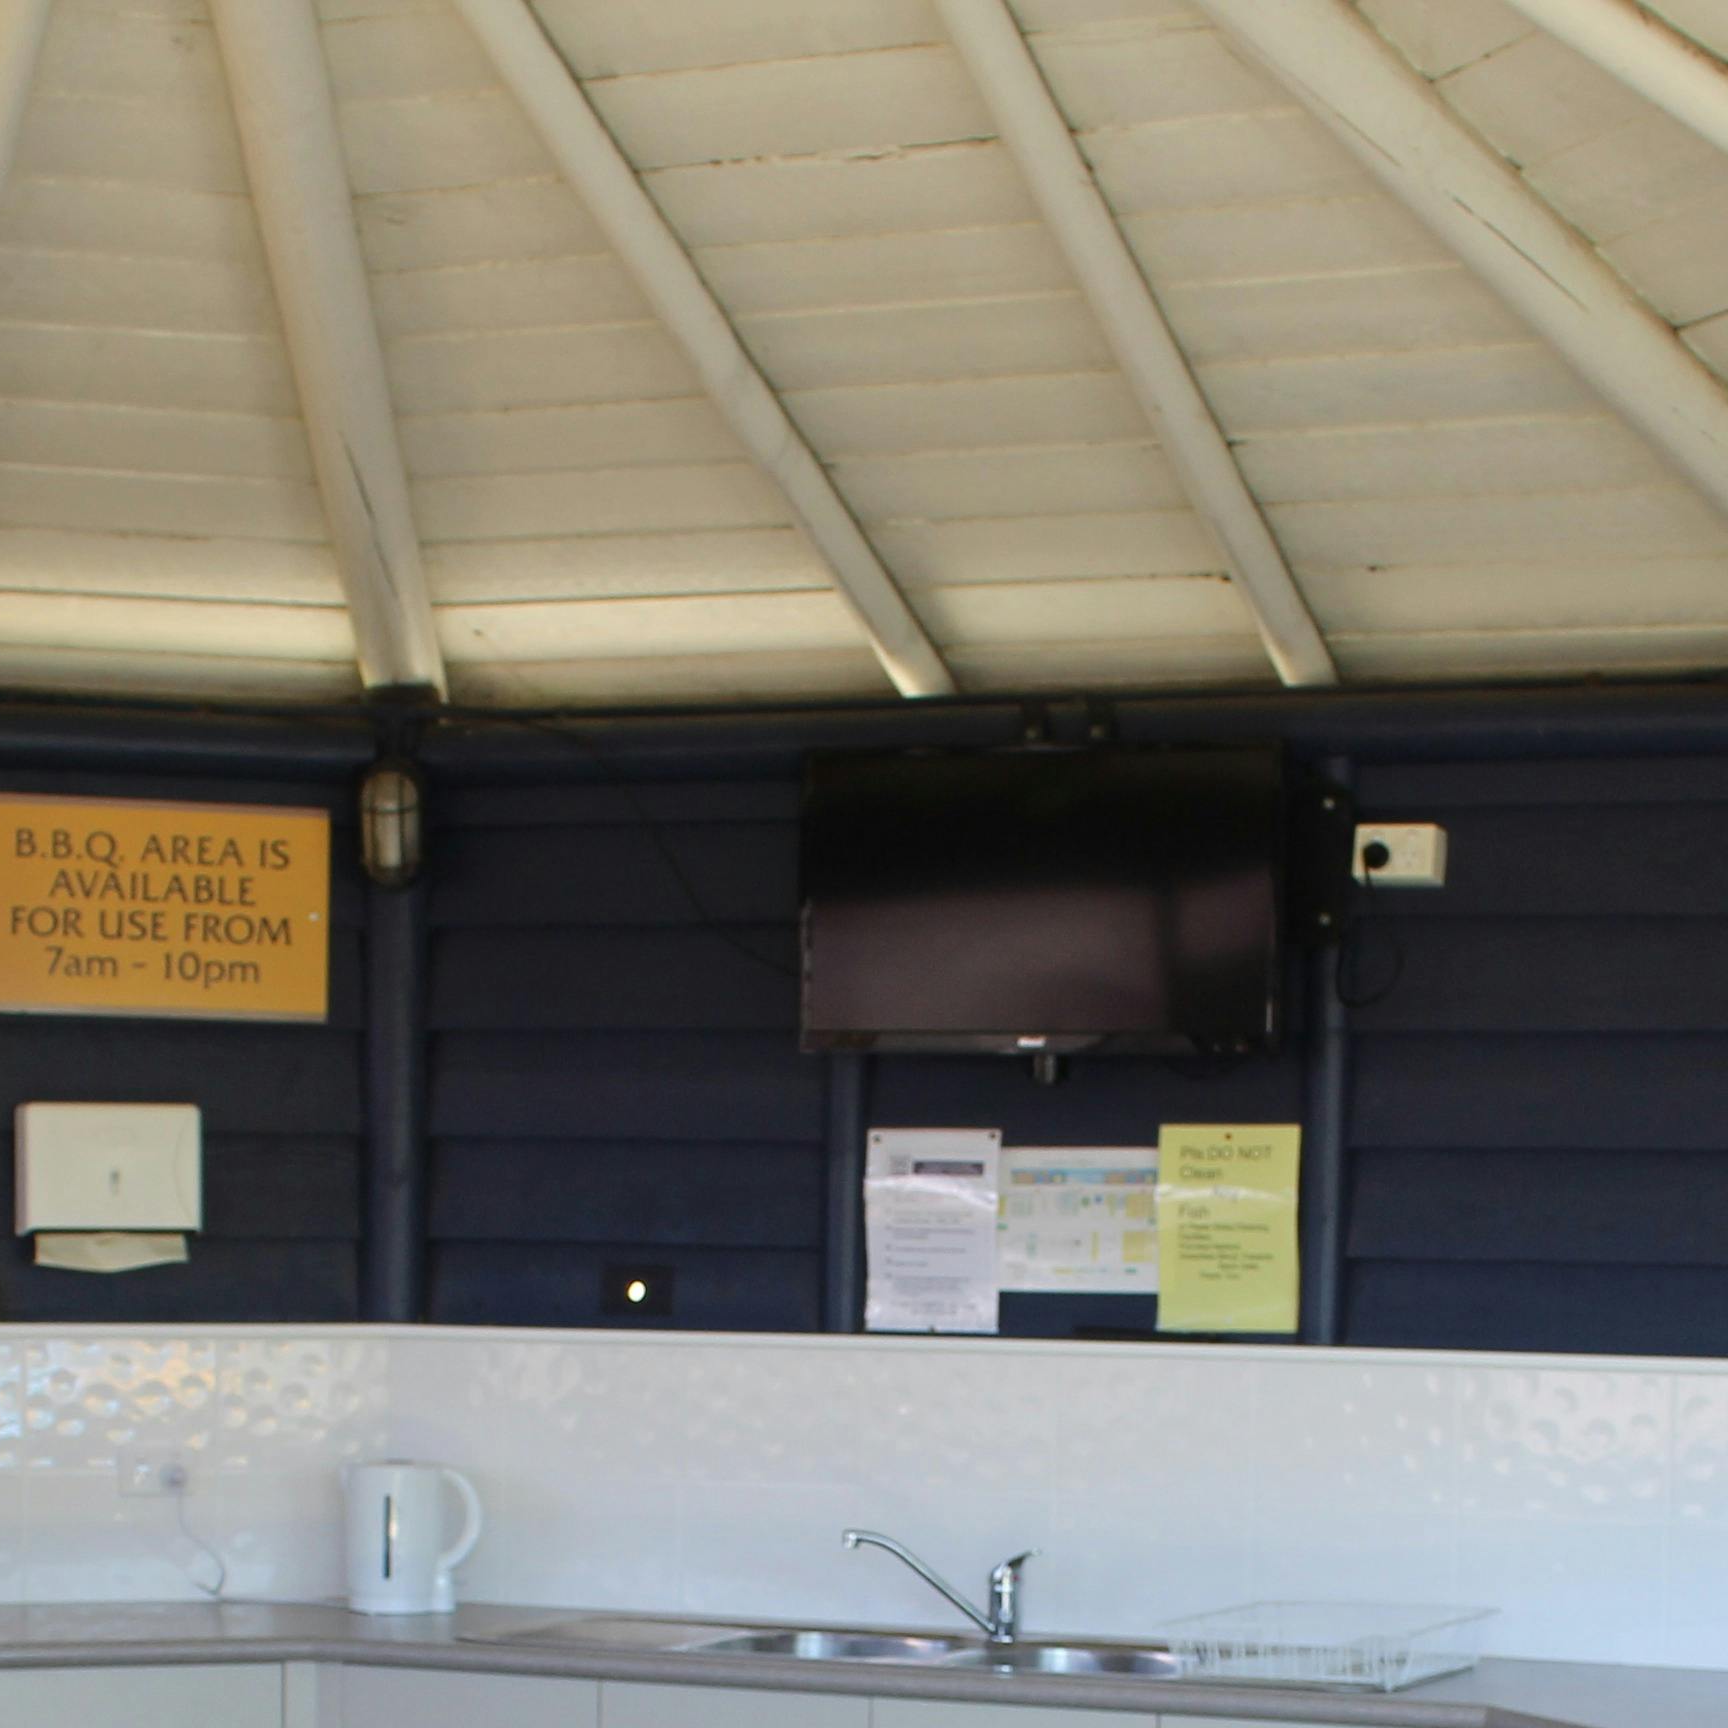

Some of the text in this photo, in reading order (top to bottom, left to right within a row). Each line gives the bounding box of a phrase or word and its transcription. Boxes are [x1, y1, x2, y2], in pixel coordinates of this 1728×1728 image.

[15, 828, 290, 870] B.B.Q. AREA IS
[49, 869, 256, 907] AVAILABLE
[10, 906, 292, 945] FOR USE FROM
[46, 945, 119, 978] 7am
[164, 951, 261, 988] 10pm
[1237, 1145, 1273, 1160] NOT
